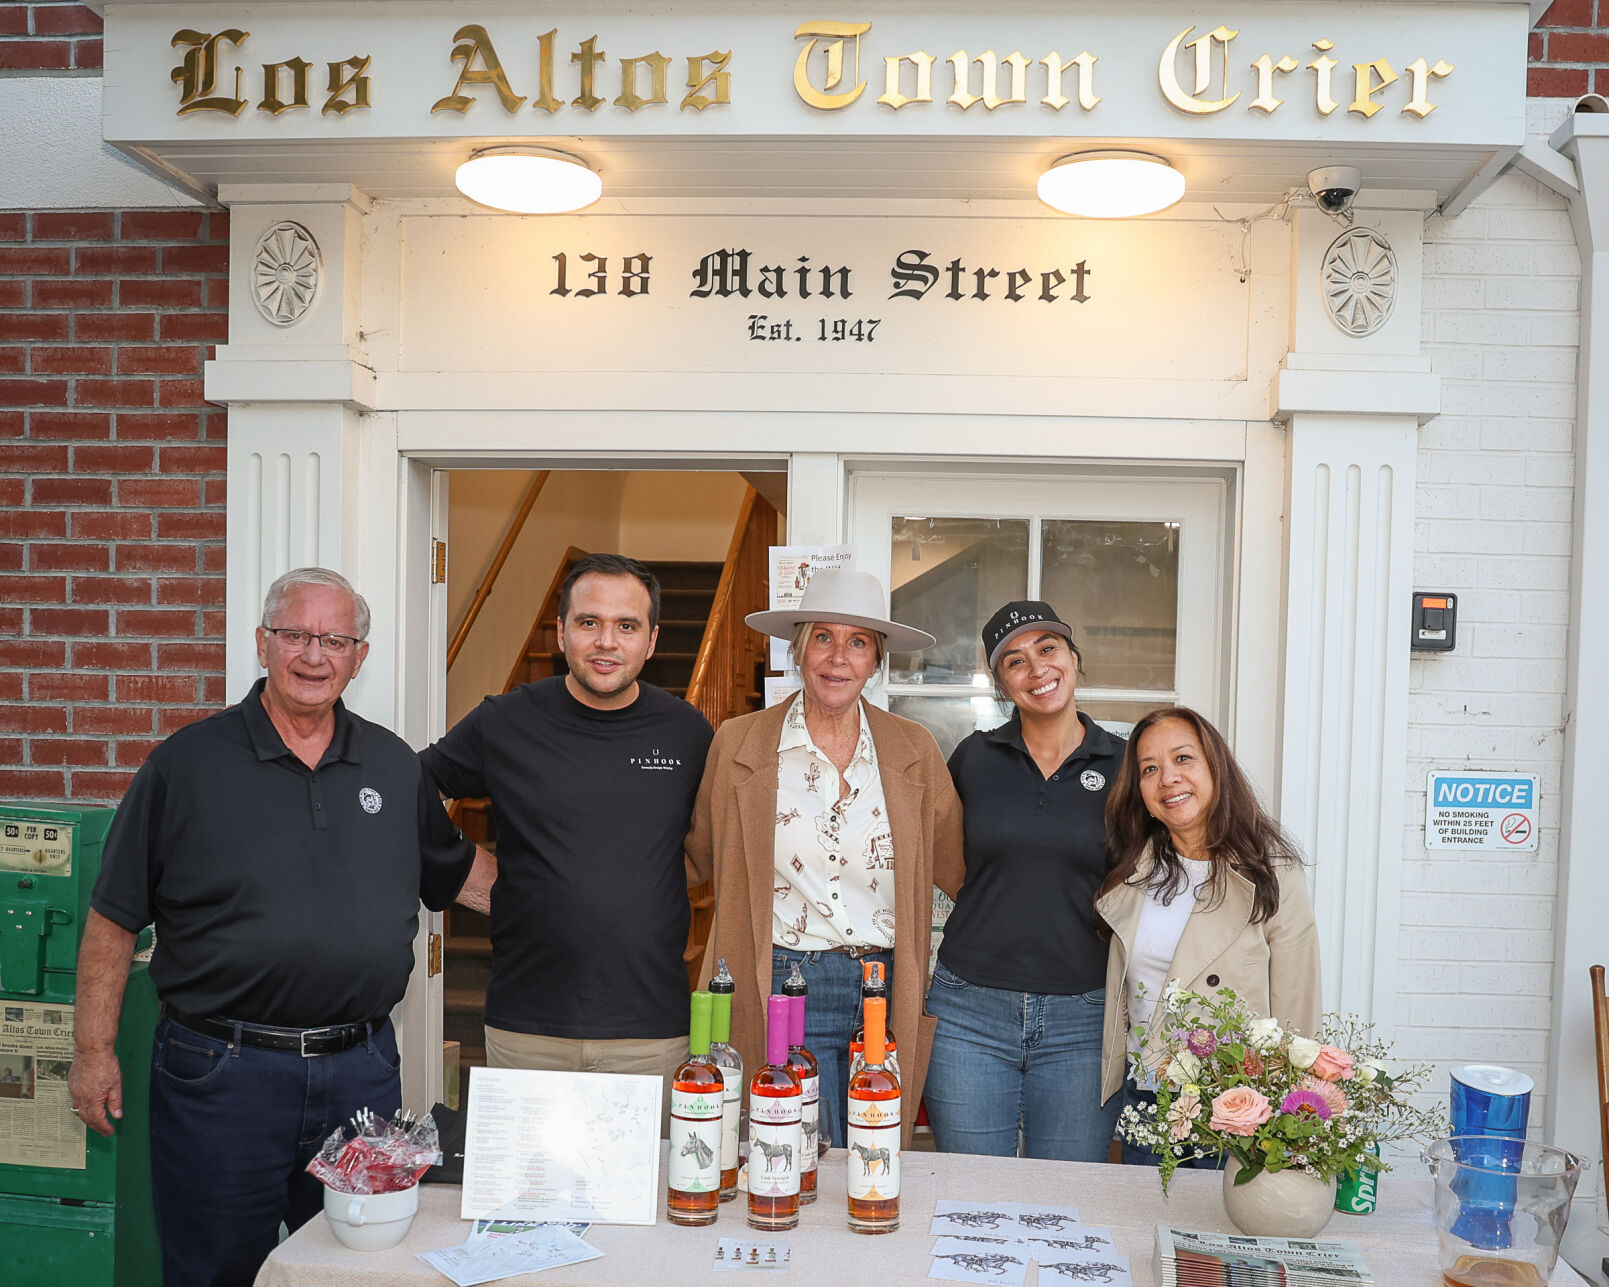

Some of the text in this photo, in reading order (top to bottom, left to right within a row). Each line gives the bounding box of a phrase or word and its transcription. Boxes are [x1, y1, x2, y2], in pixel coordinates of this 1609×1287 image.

[170, 21, 1455, 119] Los Altos Town Crier
[549, 247, 1092, 303] 138 Main Street
[747, 314, 882, 343] Est. 1947
[836, 553, 852, 562] Enjoy
[994, 614, 1044, 640] PINHOOK
[630, 758, 681, 766] PINHOOK
[1438, 782, 1529, 804] NOTICE
[1452, 811, 1489, 819] SMOKING
[1433, 819, 1461, 827] WITHIN
[1450, 828, 1488, 836] BUILDING
[1441, 836, 1485, 844] ENTRANCE
[2, 1024, 74, 1037] Altos Town Crier
